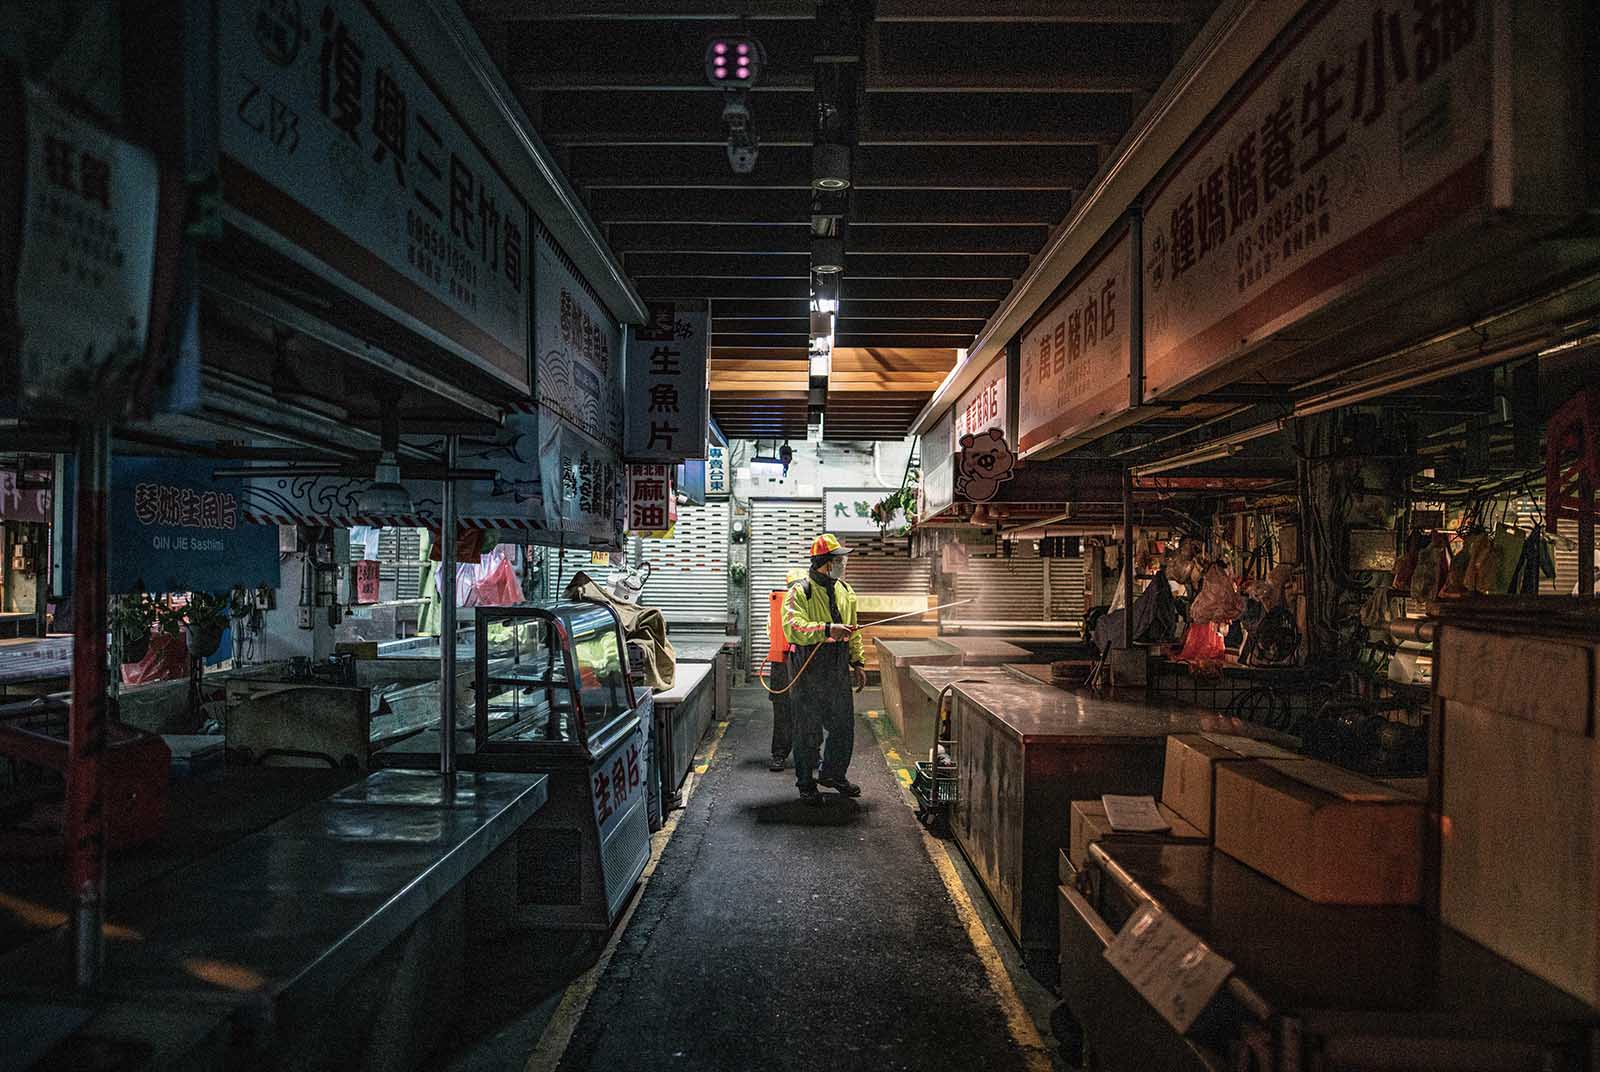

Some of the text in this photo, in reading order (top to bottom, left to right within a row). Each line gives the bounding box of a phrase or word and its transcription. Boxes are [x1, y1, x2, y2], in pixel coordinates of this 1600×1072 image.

[1039, 276, 1117, 385] 萬昌豬肉店
[647, 345, 681, 451] 生魚片
[152, 536, 225, 552] QIN JIE Sashimi
[633, 478, 665, 527] 麻油
[594, 743, 640, 826] 生魚片
